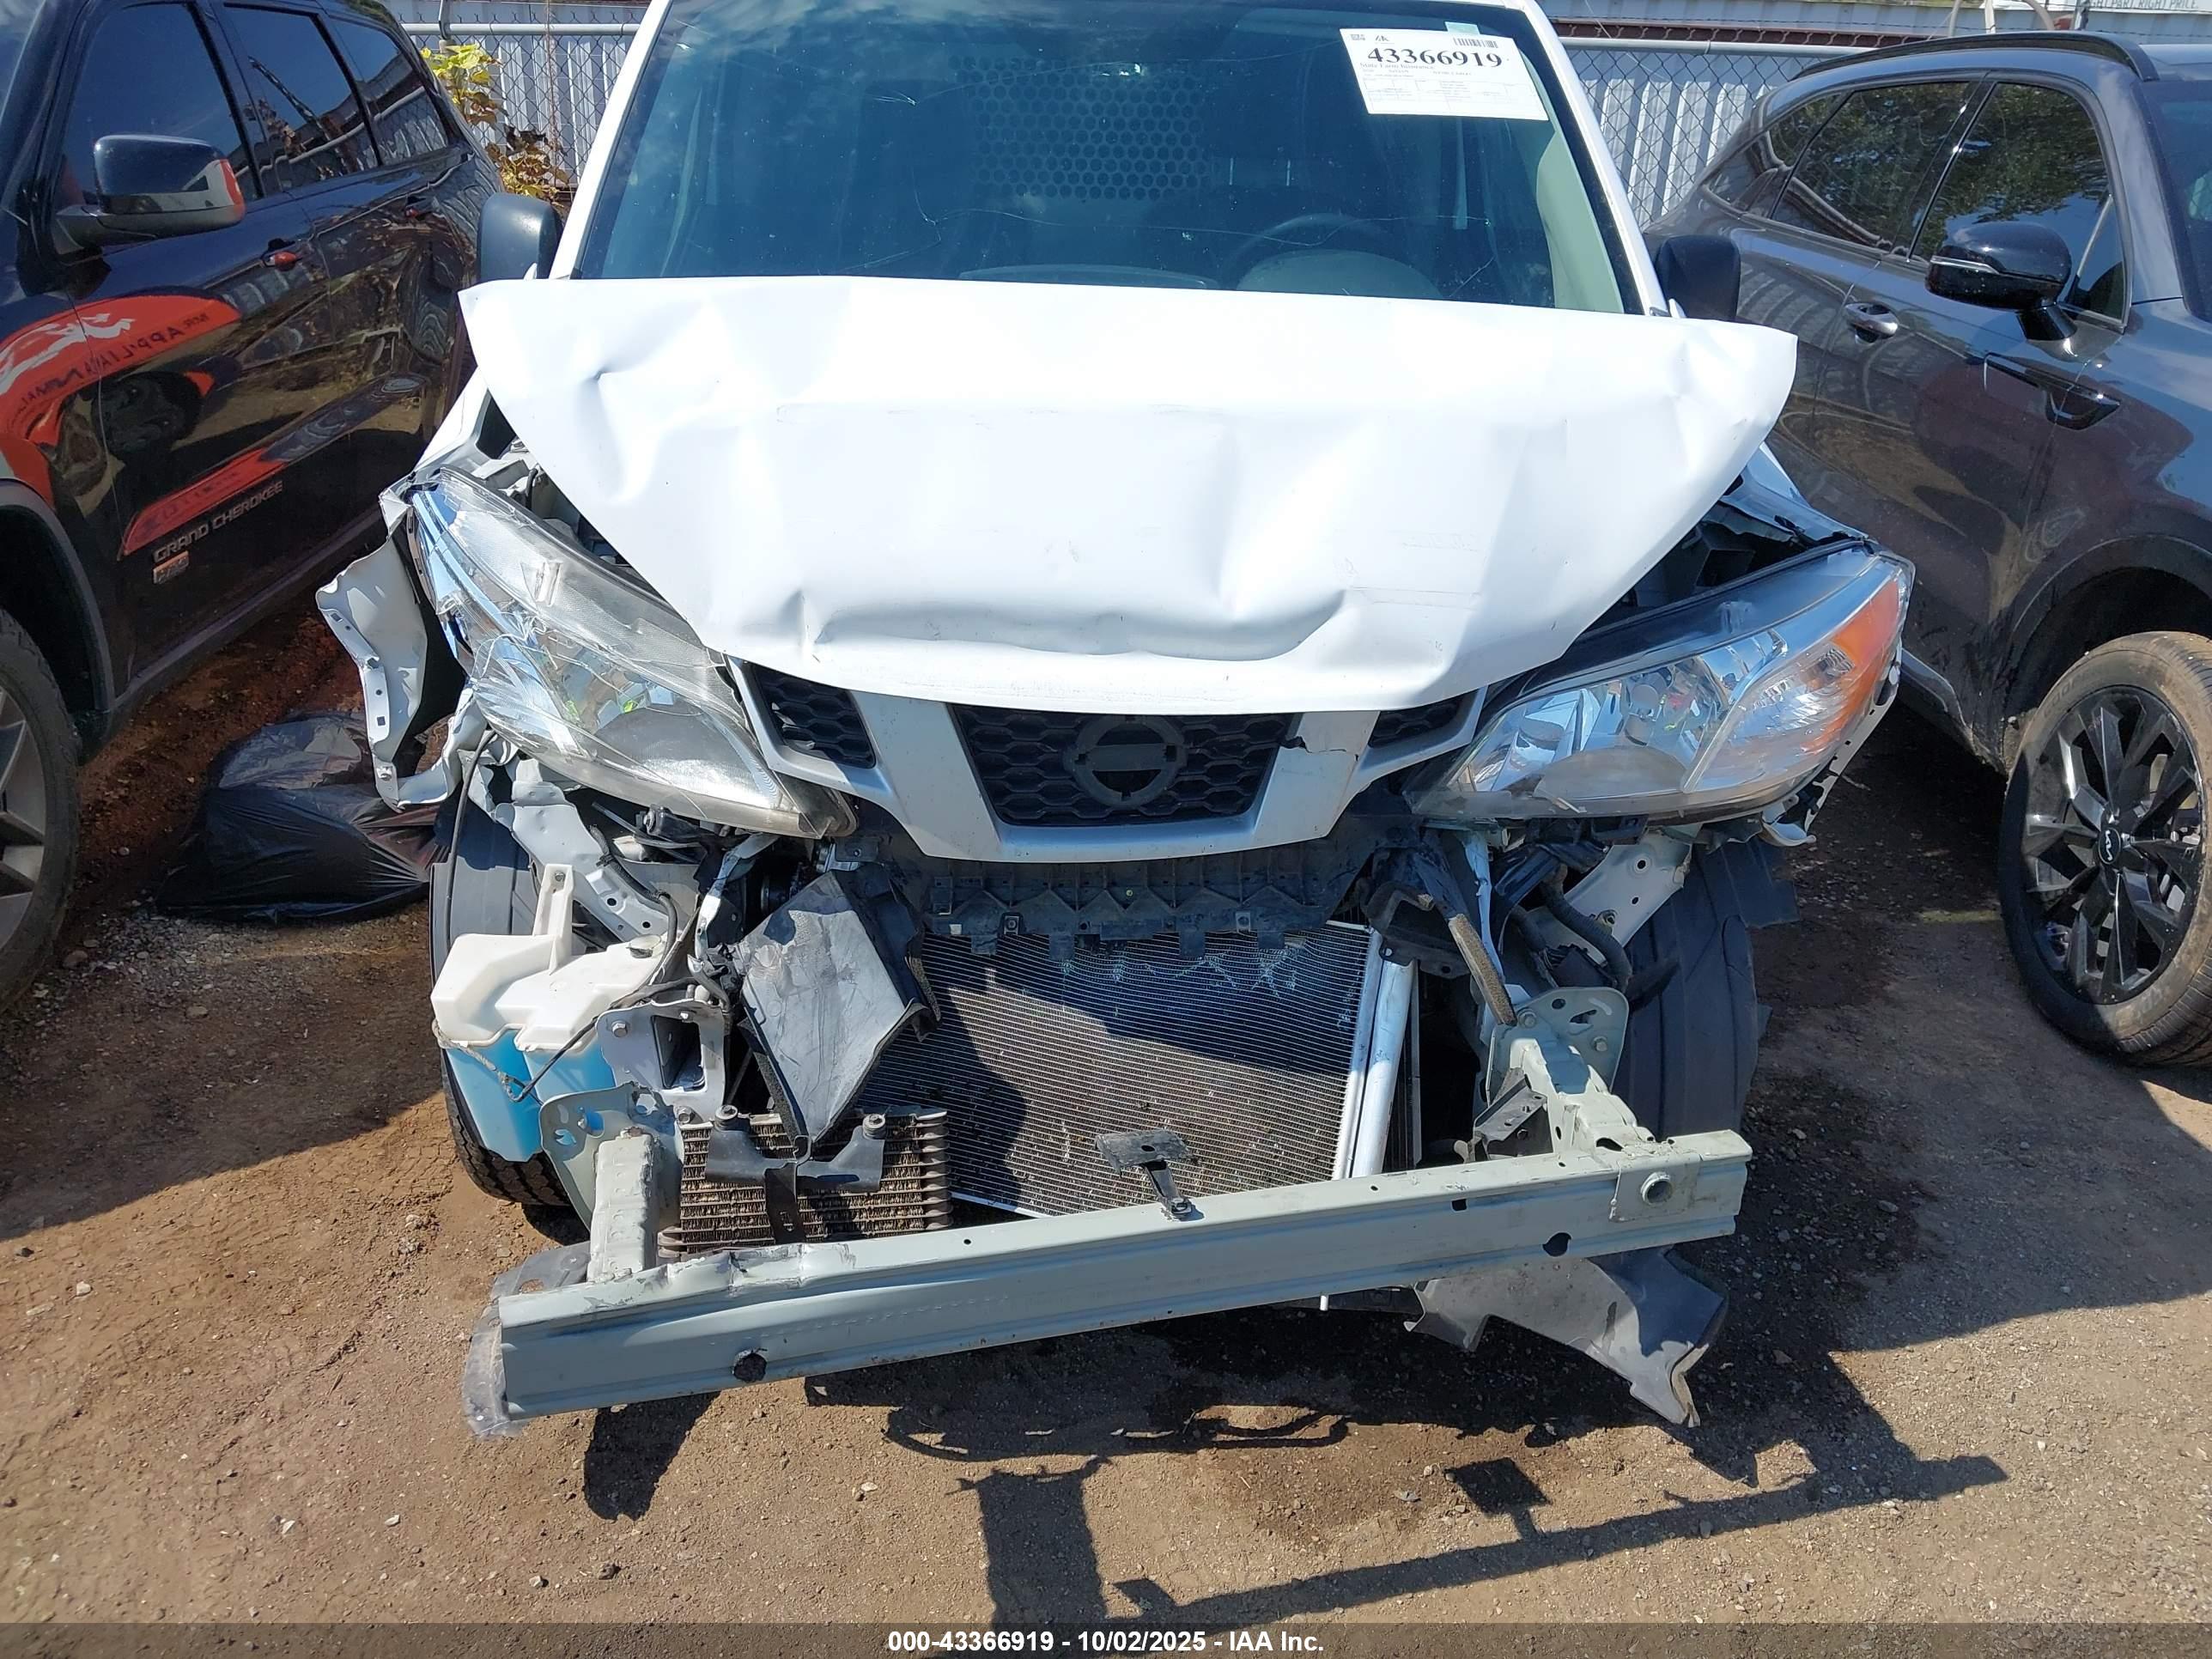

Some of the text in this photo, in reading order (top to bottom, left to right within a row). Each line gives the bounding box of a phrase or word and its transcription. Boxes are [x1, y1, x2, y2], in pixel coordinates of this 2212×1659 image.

[1367, 47, 1503, 69] 43366919
[153, 522, 210, 563] GRAND
[212, 481, 283, 531] CHEROKEE
